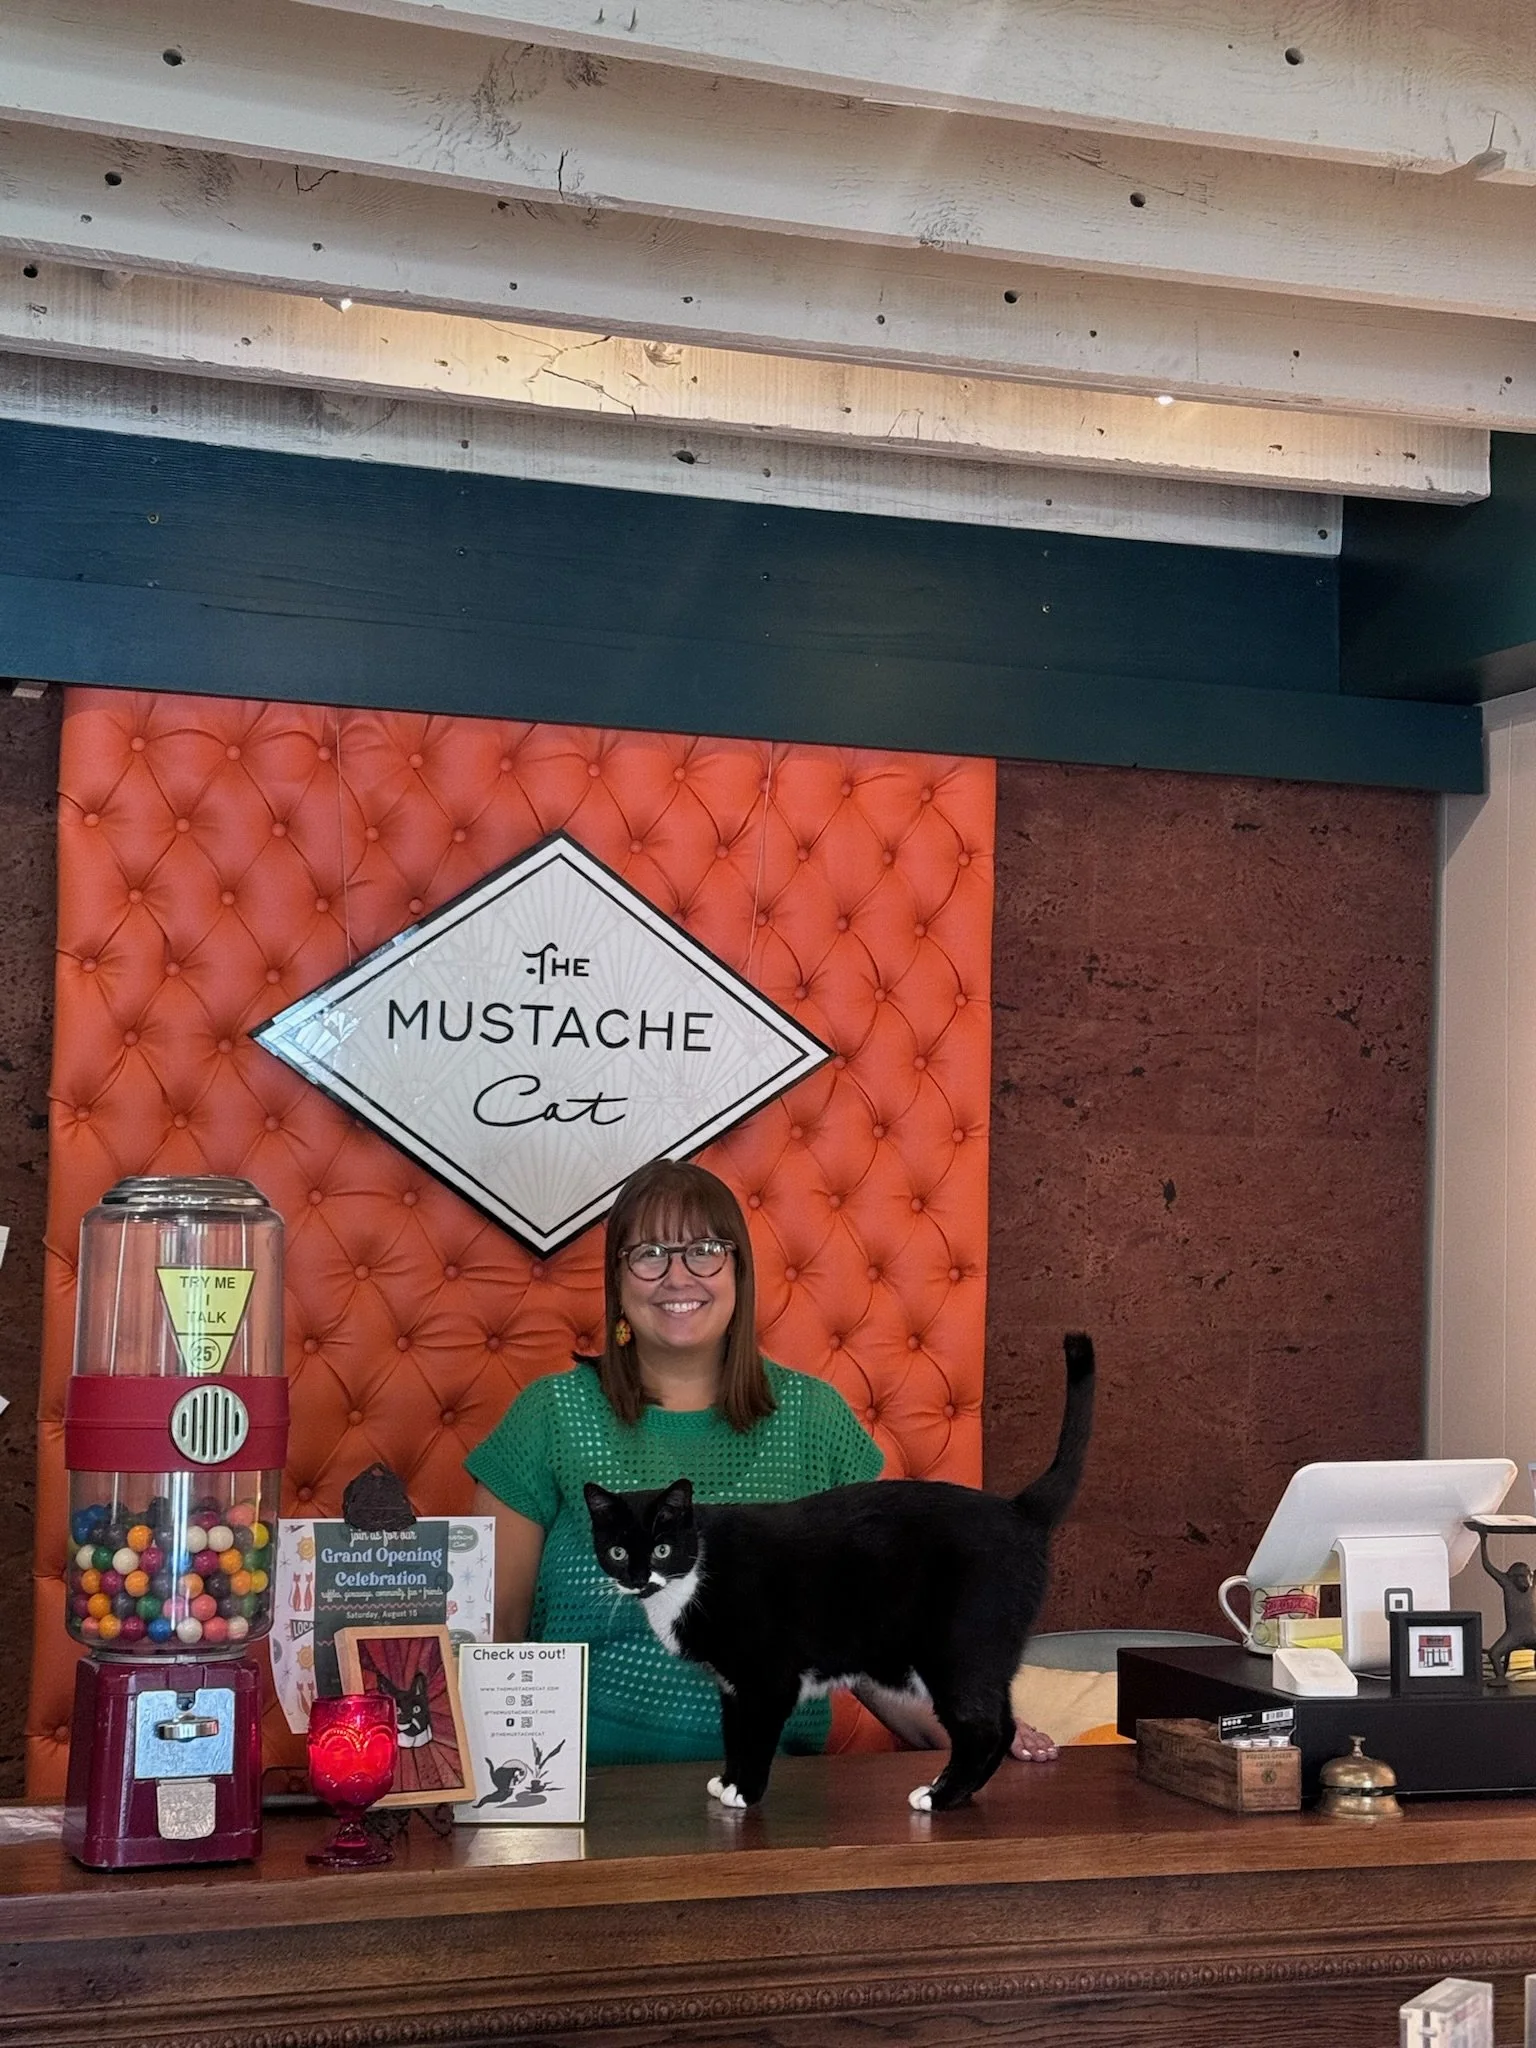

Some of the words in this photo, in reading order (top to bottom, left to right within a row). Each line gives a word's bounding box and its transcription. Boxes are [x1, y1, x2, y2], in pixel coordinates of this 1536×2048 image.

[522, 942, 590, 985] THE
[387, 999, 714, 1052] MUSTACHE
[472, 1074, 629, 1127] Cat
[179, 1275, 210, 1289] TRY
[214, 1276, 236, 1289] ME
[206, 1294, 210, 1306] I
[349, 1528, 369, 1548] join
[370, 1531, 382, 1541] us
[382, 1529, 399, 1548] for
[400, 1530, 418, 1541] our
[321, 1547, 373, 1564] Grand
[375, 1546, 443, 1569] Opening
[334, 1570, 427, 1588] Celebration
[382, 1610, 407, 1620] August
[472, 1648, 515, 1661] Check
[519, 1649, 535, 1660] us
[538, 1647, 566, 1660] out!
